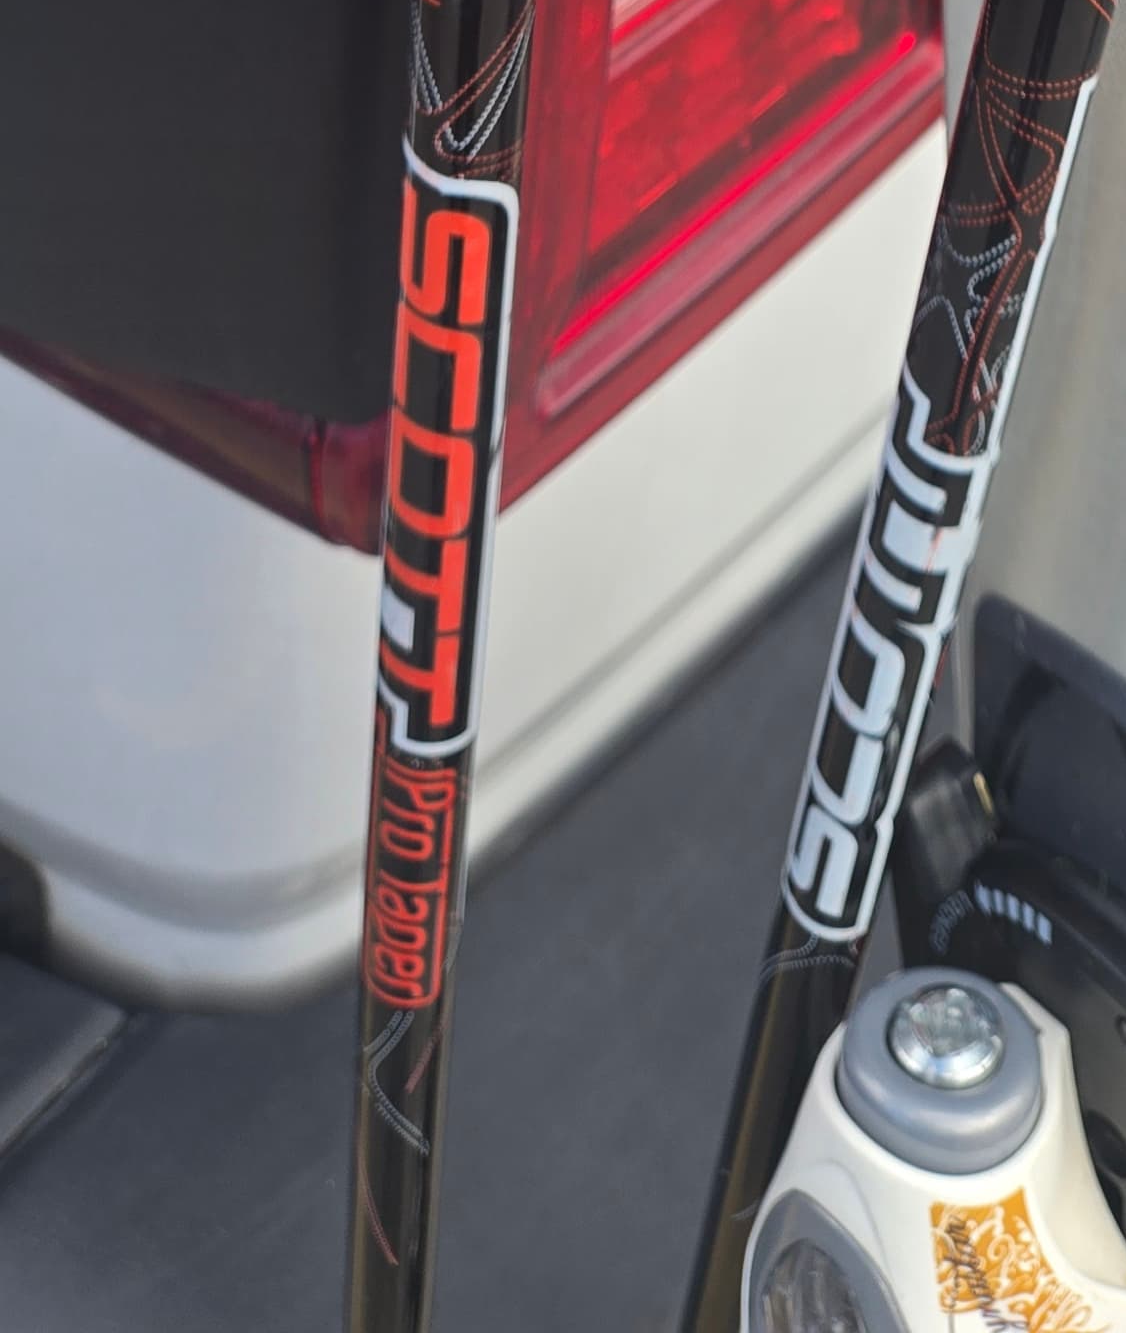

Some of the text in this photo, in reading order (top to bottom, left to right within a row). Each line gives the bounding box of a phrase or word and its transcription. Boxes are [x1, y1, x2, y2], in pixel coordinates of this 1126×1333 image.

[379, 178, 489, 725] SCOTT
[788, 399, 947, 918] SCOTT
[380, 765, 457, 861] Pro
